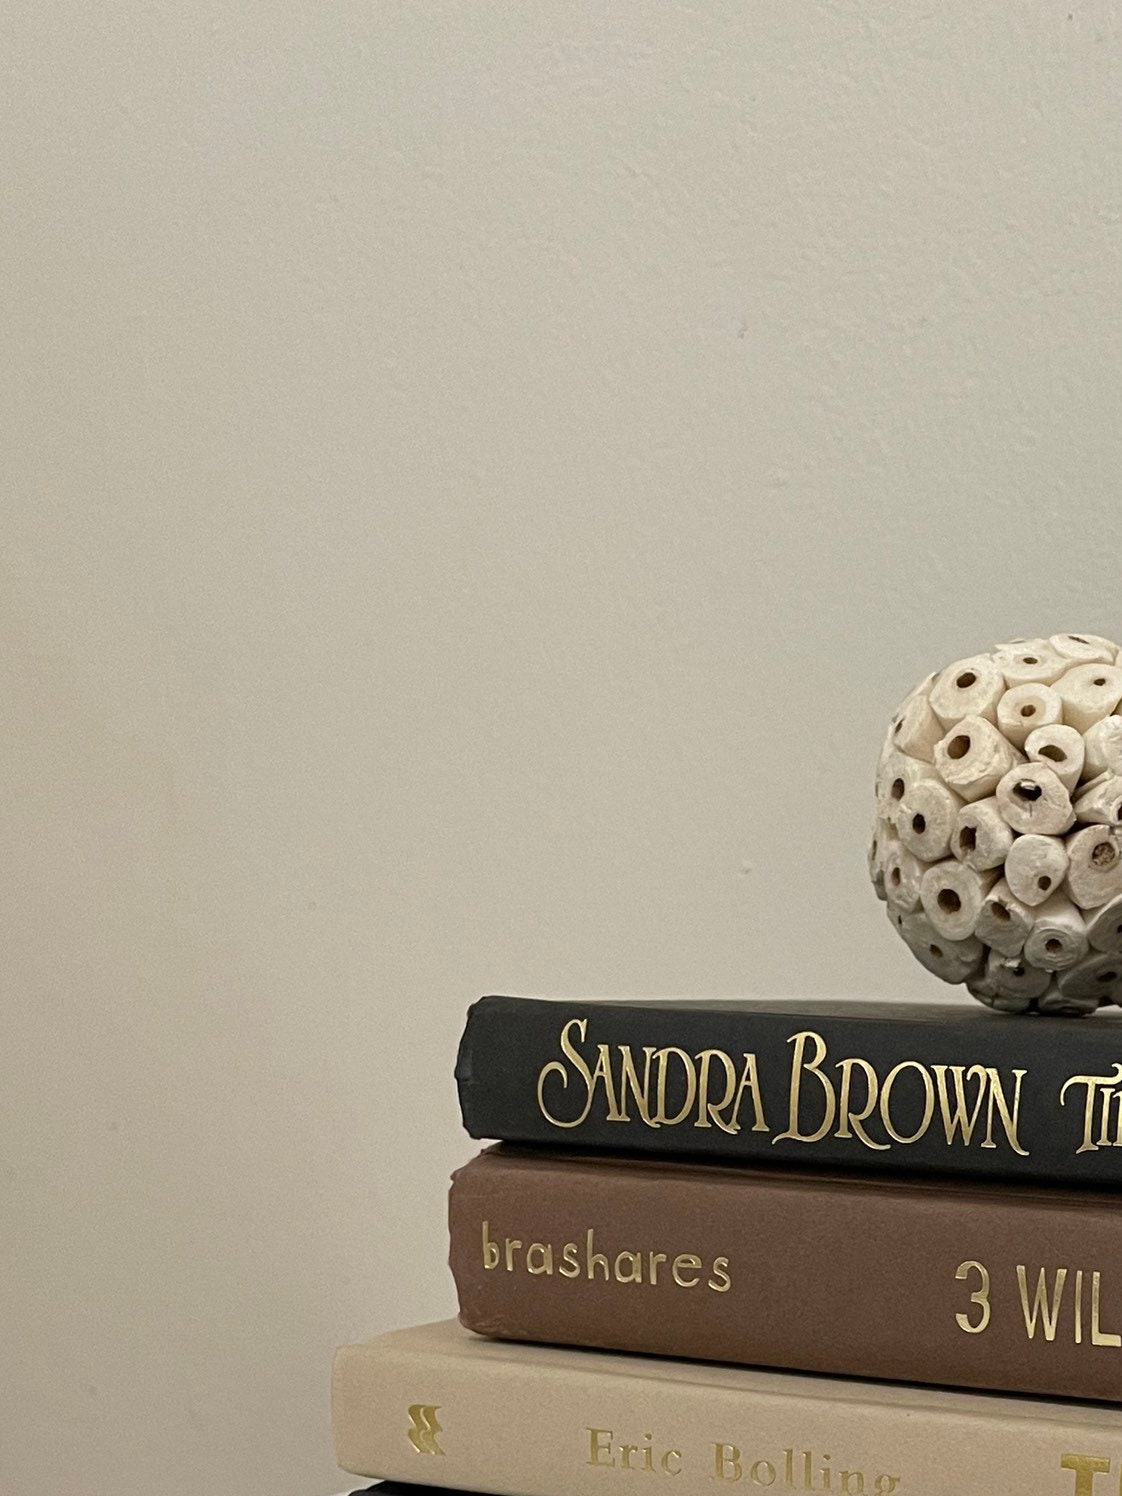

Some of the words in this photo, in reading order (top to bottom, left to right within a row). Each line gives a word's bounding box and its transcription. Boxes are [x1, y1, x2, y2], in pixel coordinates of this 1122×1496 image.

[536, 1018, 769, 1135] SANDRA
[772, 1030, 1029, 1157] BROWN
[481, 1221, 731, 1293] brashares
[954, 1260, 991, 1334] 3
[585, 1426, 682, 1477] Eric
